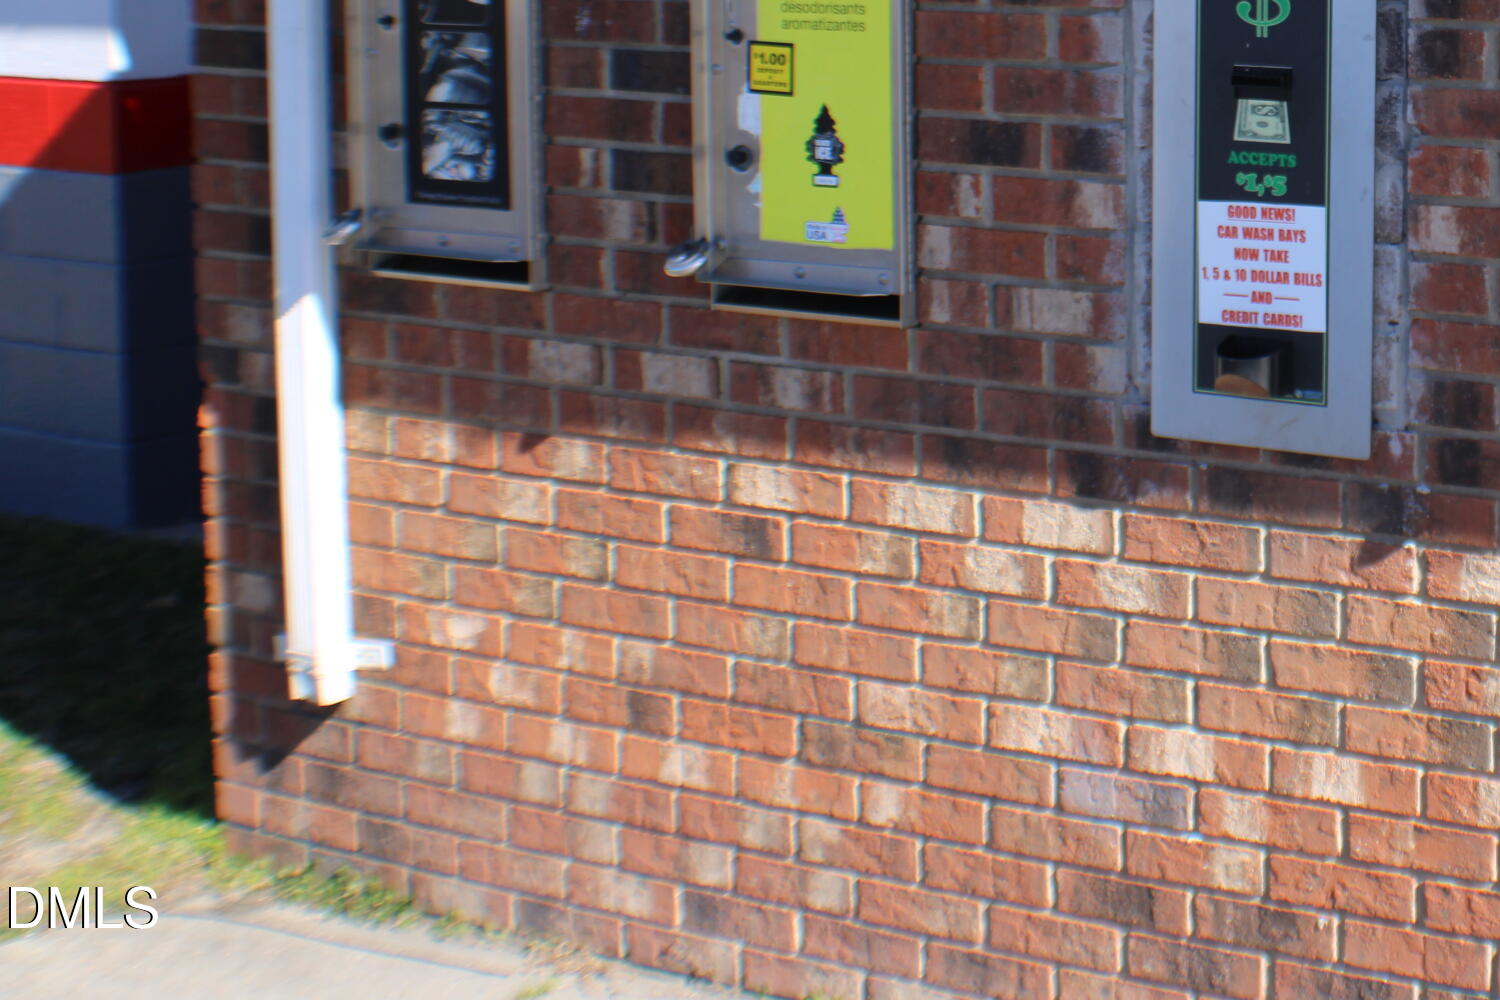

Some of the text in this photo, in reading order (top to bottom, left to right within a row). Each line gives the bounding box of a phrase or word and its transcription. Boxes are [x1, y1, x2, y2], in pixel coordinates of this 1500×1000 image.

[1227, 151, 1297, 168] ACCEPTS
[1227, 205, 1296, 222] GOOD NEWS!
[1217, 225, 1307, 243] CAR WASH BAYS
[1234, 248, 1290, 263] NOW TAKE
[1212, 267, 1220, 280] 5
[1224, 270, 1232, 280] &
[1236, 269, 1247, 281] 10
[1251, 270, 1290, 285] DOLLAR
[1294, 272, 1323, 287] BILLS
[1251, 291, 1273, 305] AND
[1221, 310, 1303, 328] CREDIT CARDS!
